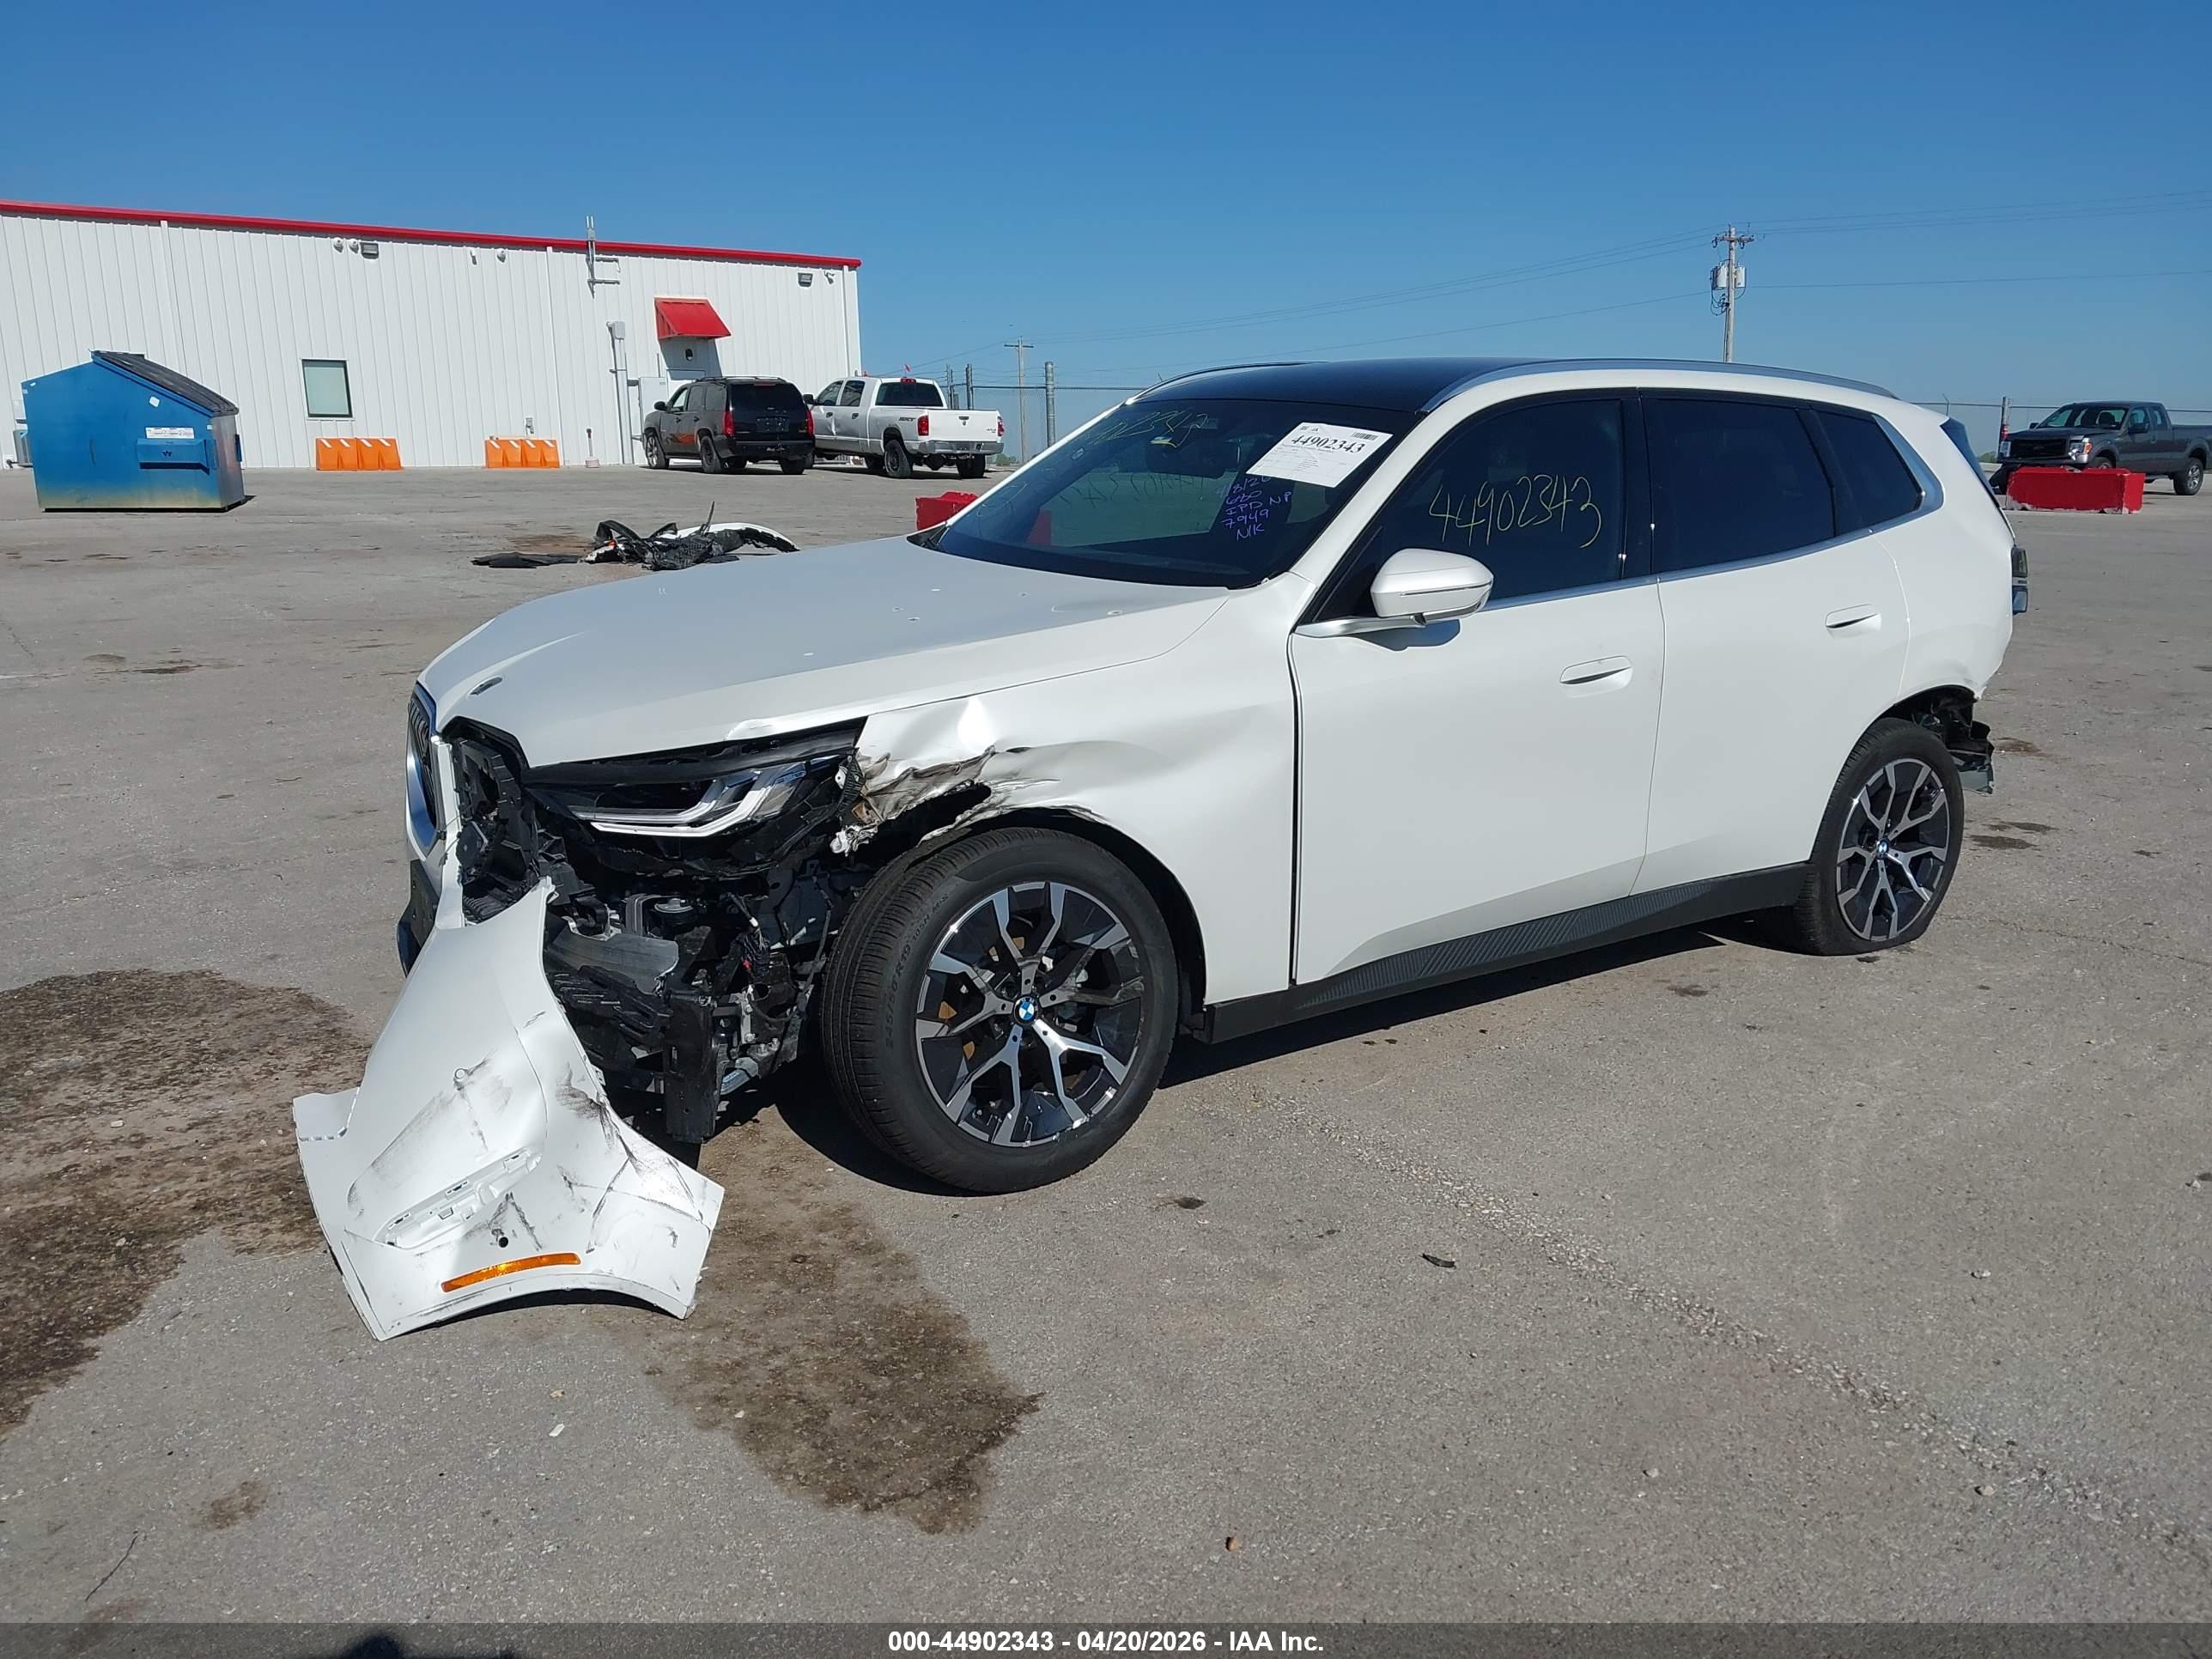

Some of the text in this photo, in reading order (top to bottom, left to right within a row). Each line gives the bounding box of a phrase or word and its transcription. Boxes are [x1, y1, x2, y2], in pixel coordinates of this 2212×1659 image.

[1291, 434, 1366, 453] 44902343
[1222, 508, 1269, 529] 7949
[1429, 474, 1601, 549] 44902343
